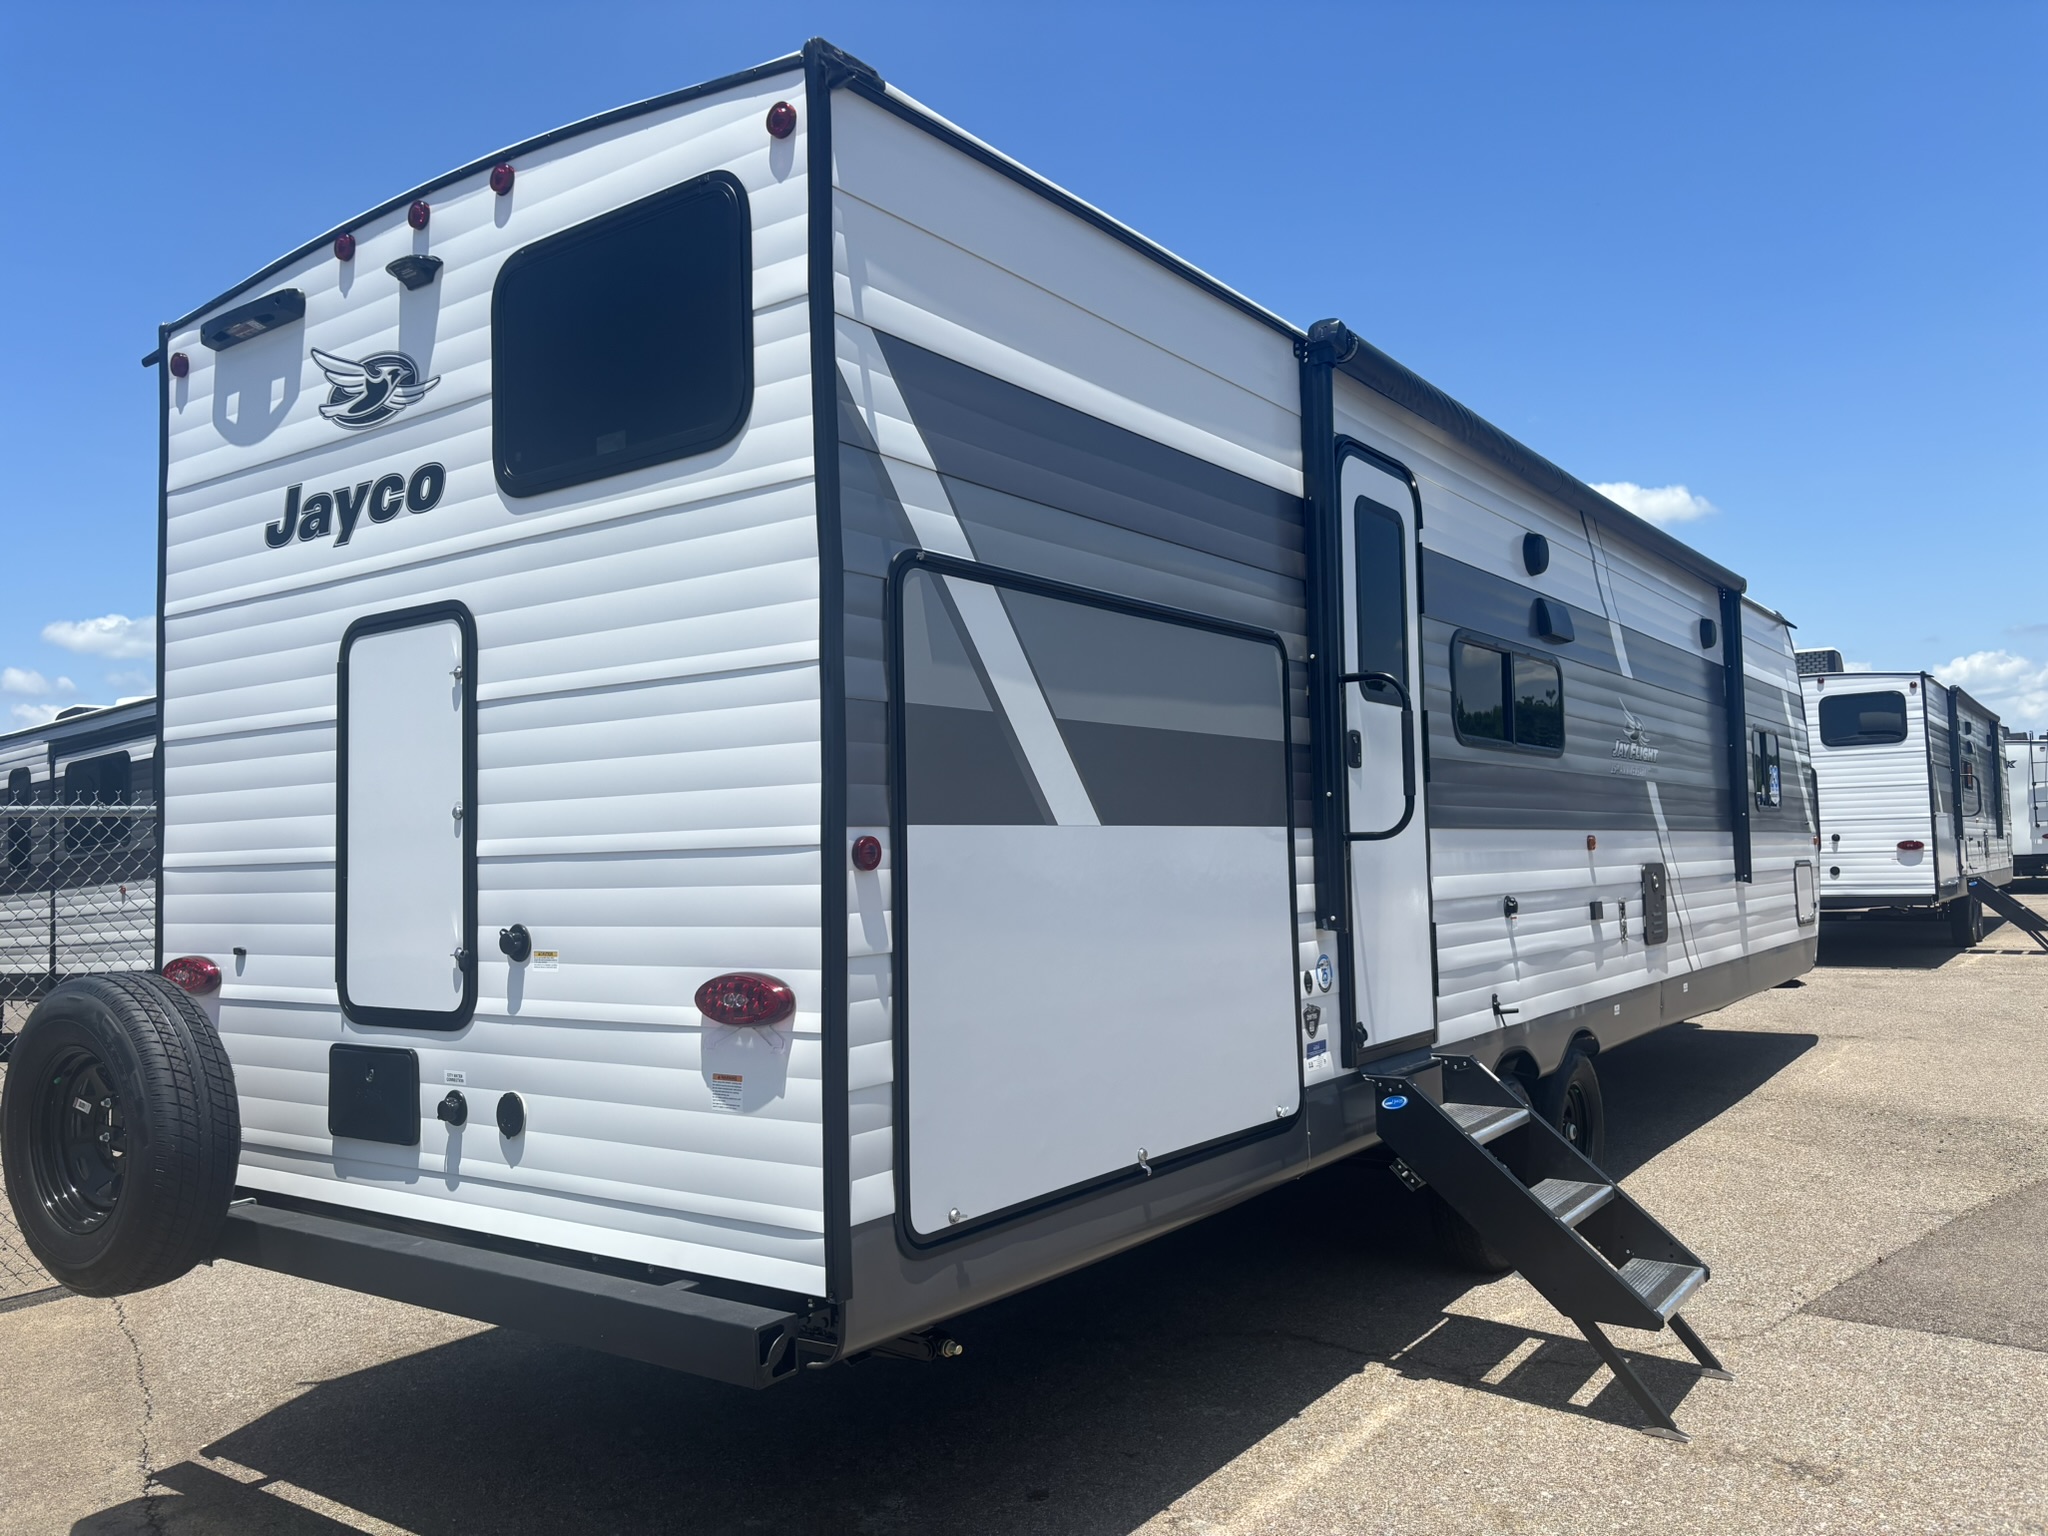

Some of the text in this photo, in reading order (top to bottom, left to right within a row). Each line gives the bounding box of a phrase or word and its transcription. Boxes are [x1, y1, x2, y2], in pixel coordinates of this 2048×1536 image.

[264, 461, 447, 549] Jayco
[1612, 740, 1659, 762] JAY FLIGHT
